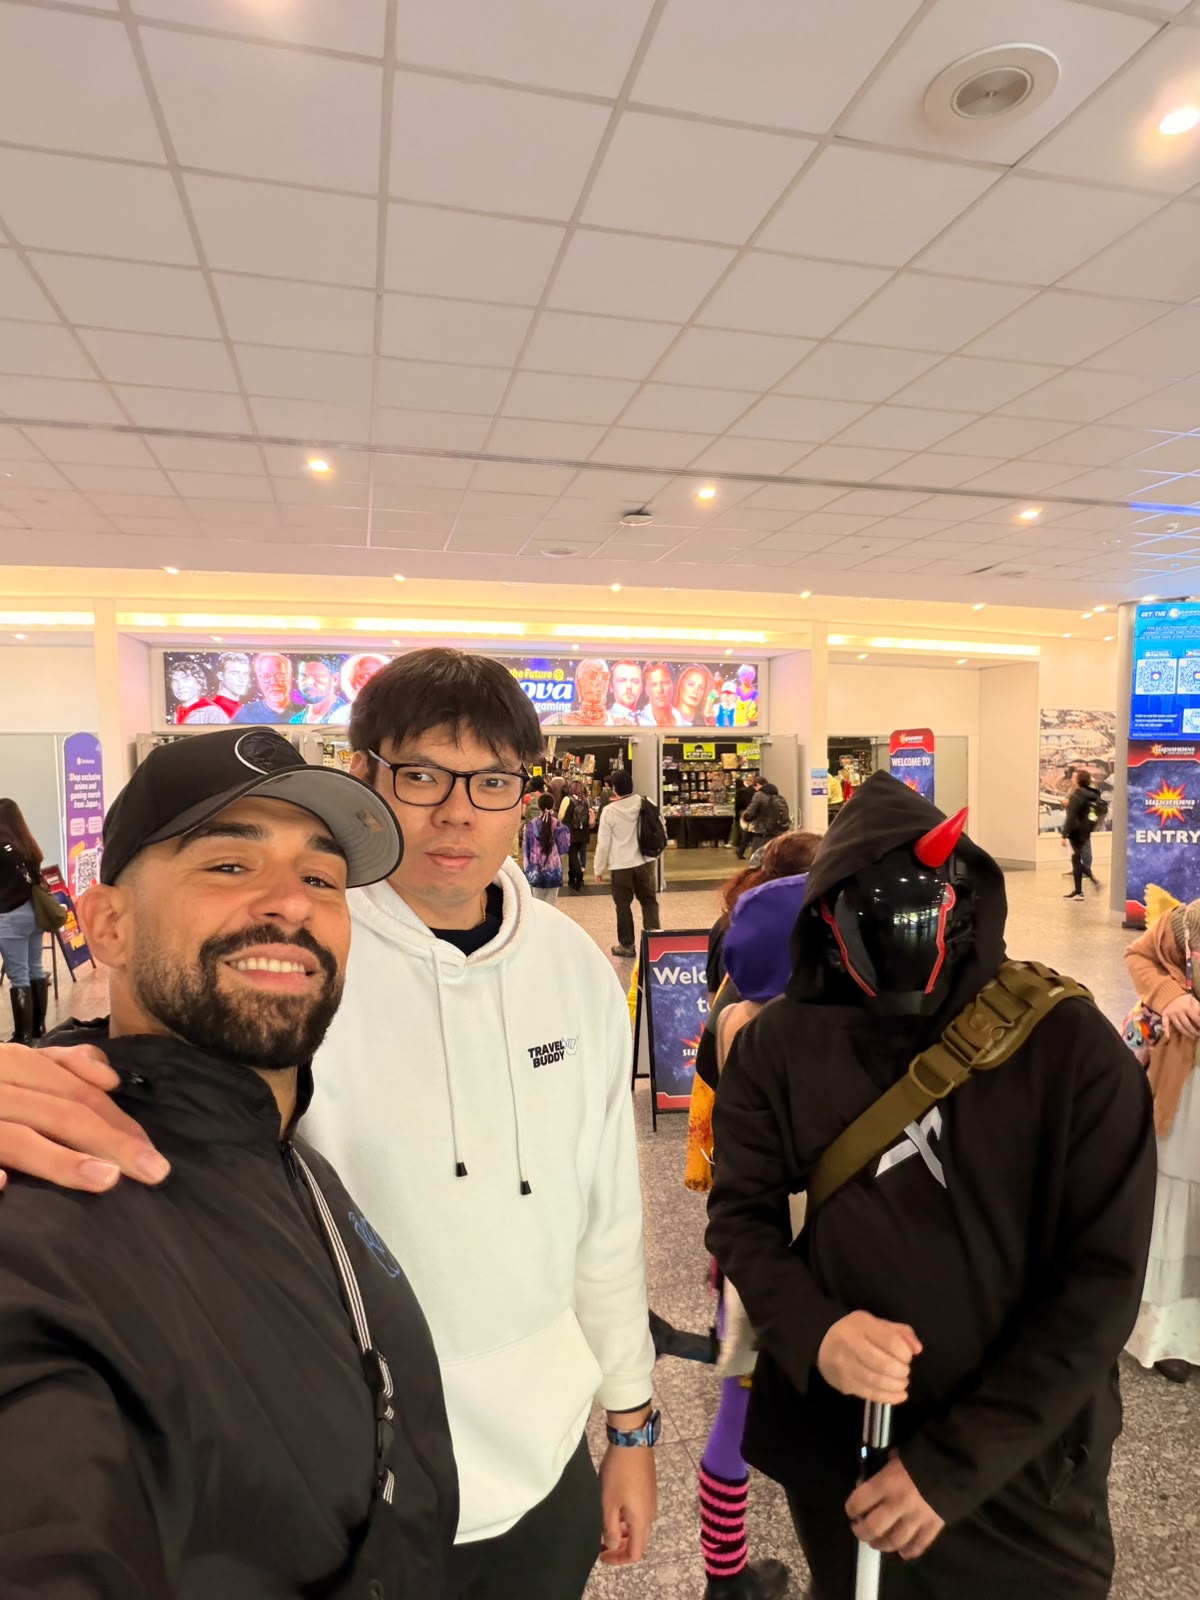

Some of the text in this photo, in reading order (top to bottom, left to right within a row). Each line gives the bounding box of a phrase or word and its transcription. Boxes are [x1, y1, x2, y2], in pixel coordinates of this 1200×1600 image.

[525, 669, 552, 678] Future
[892, 757, 930, 766] WELCOME TO
[69, 773, 81, 782] Shop
[1136, 831, 1200, 843] ENTRY
[528, 1040, 565, 1059] TRAVEL
[532, 1050, 565, 1068] BUDDY
